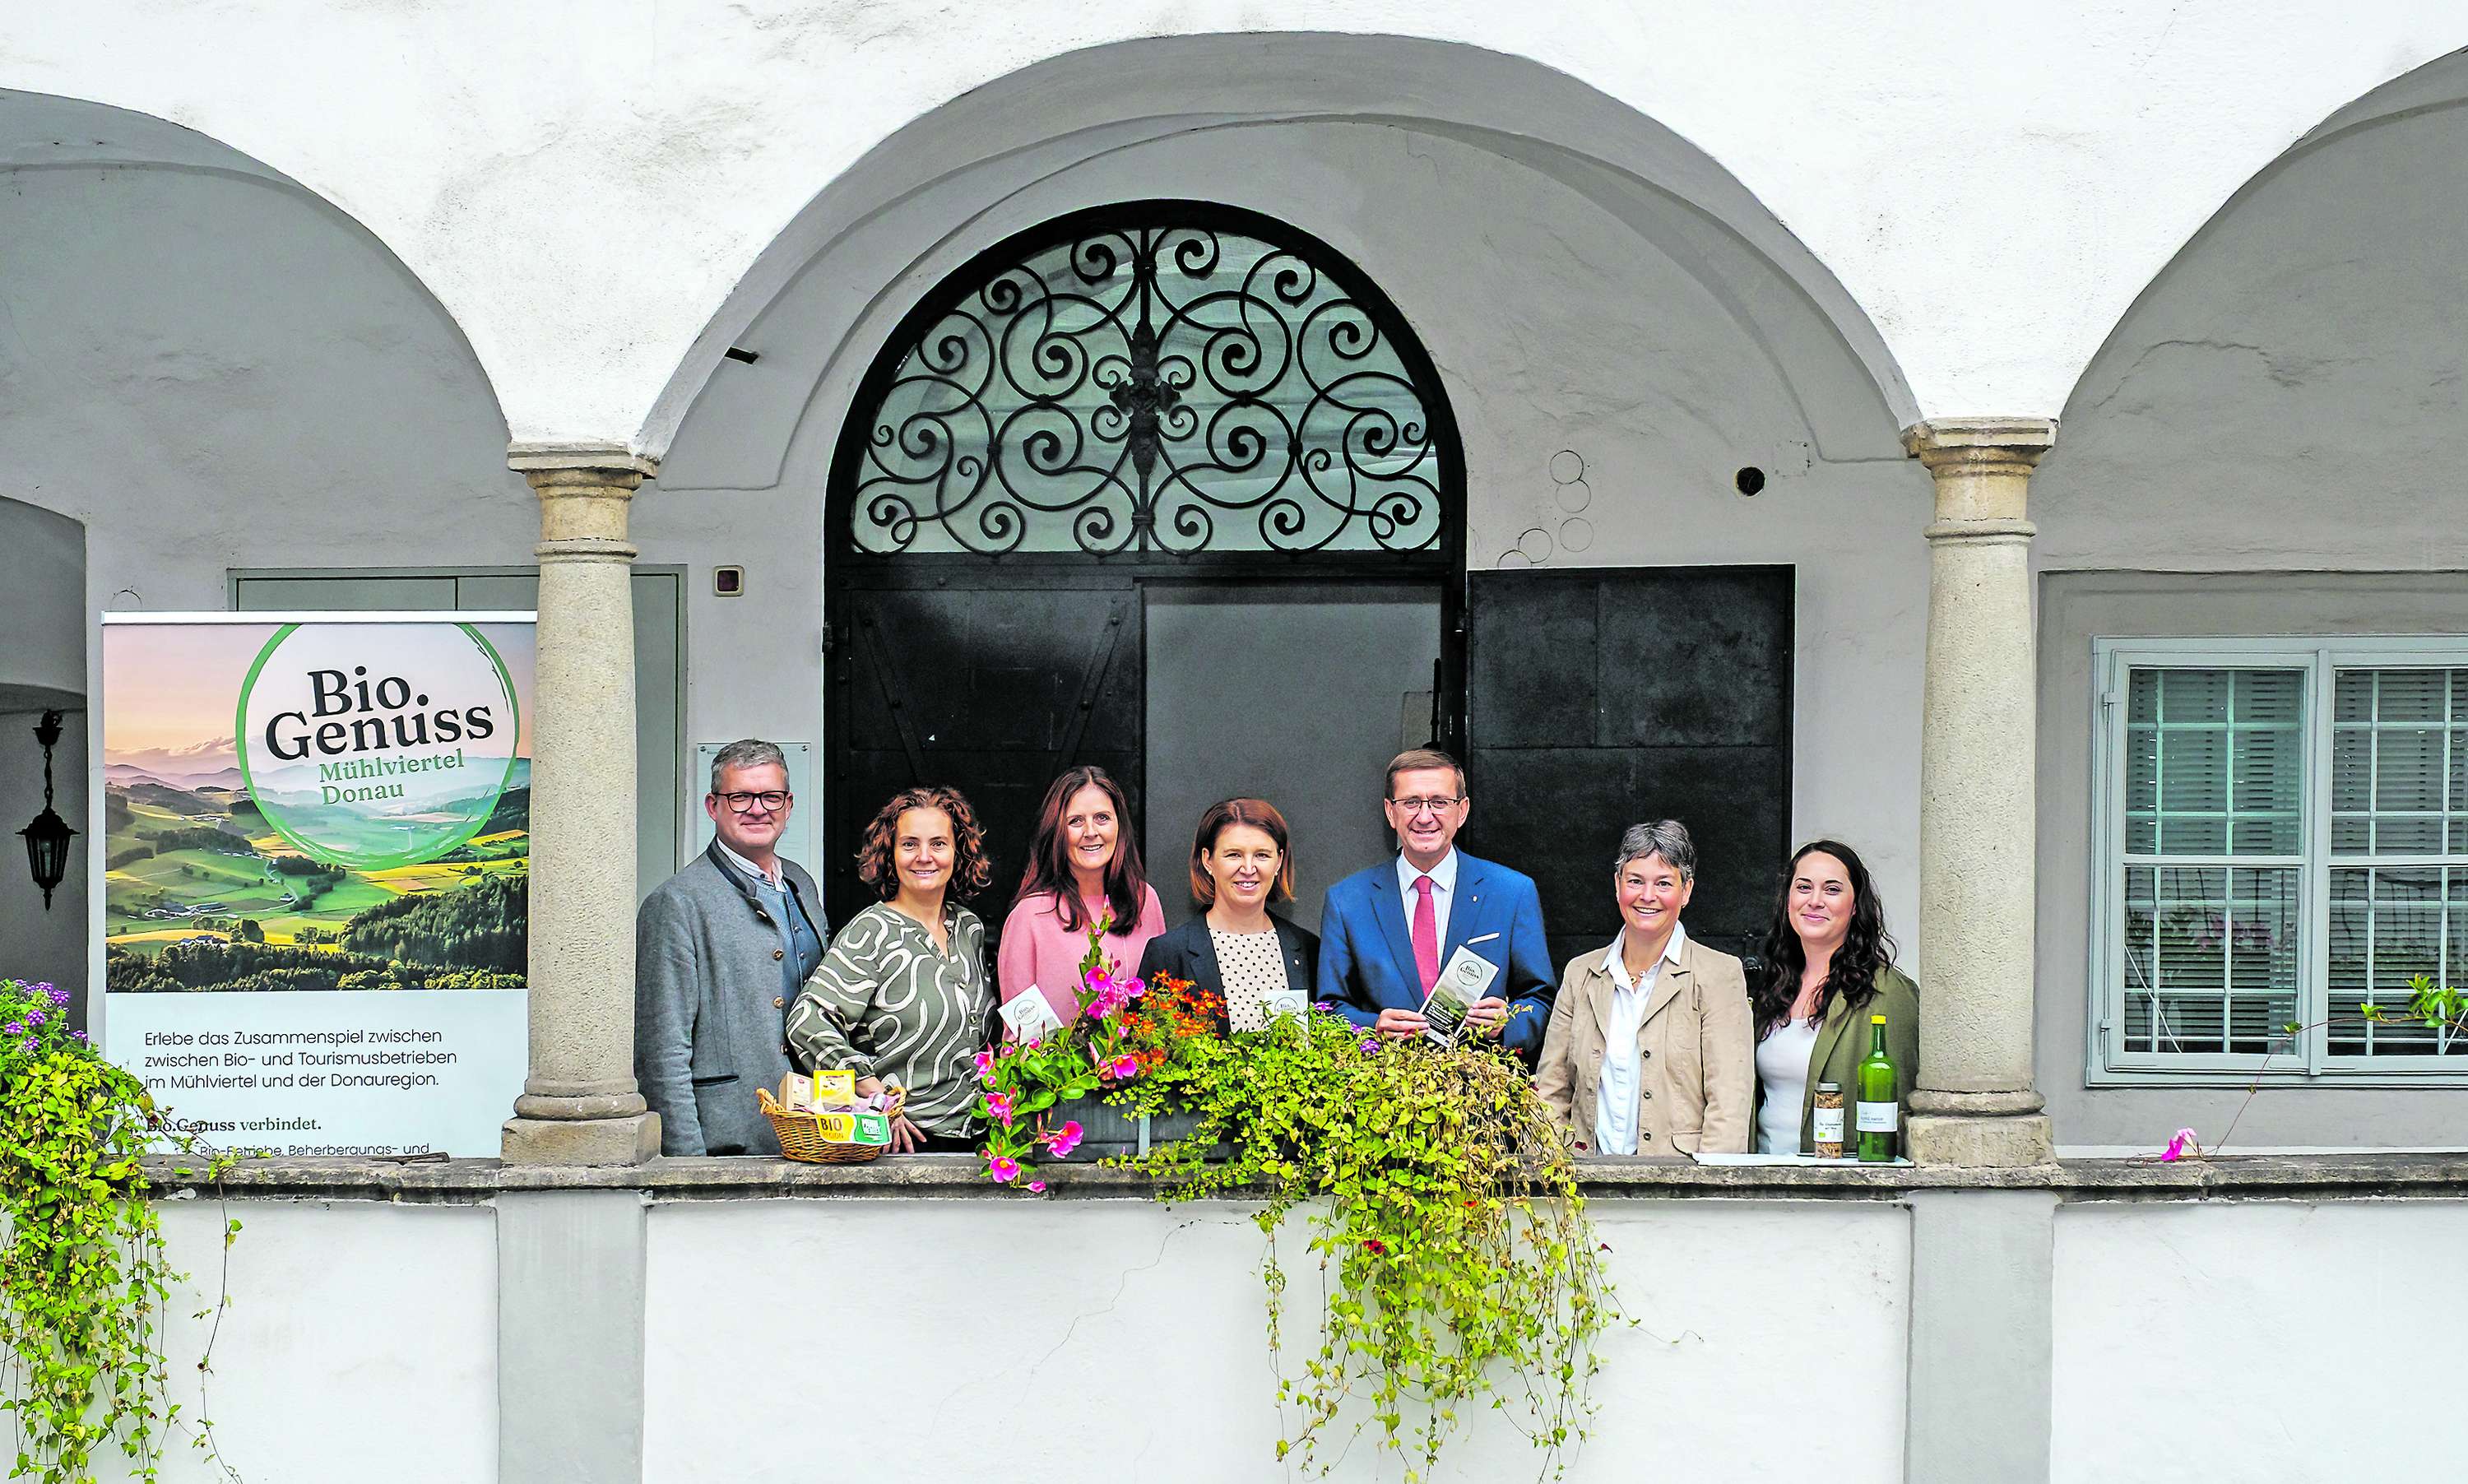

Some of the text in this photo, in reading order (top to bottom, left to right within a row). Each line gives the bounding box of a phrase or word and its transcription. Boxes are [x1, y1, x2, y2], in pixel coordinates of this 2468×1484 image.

[307, 665, 430, 718] Bio.
[265, 705, 494, 762] Genuss
[318, 747, 465, 782] Mühlviertel
[321, 782, 405, 805] Donau
[146, 1029, 441, 1047] Erlebe das Zusammenspiel zwischen
[146, 1050, 456, 1067] zwischen Bio- und Tourismusbetrieben
[145, 1073, 438, 1090] im Mühlviertel und der Donauregion.
[146, 1117, 321, 1132] Bo.Genuss verbindet.
[820, 1118, 842, 1132] BIO
[404, 1143, 430, 1155] und
